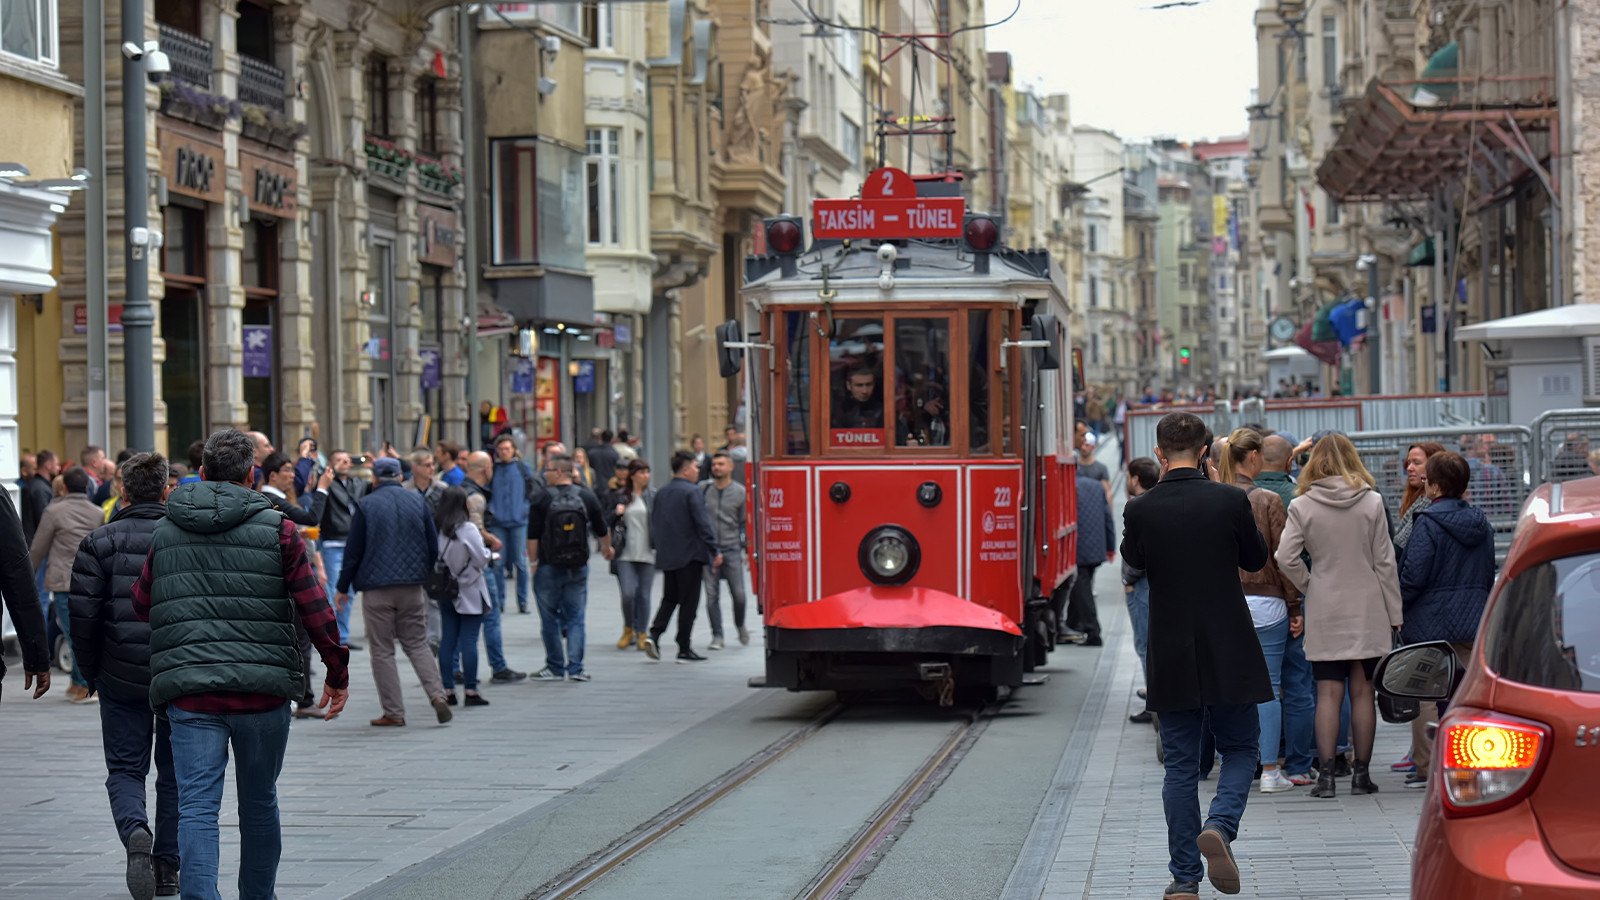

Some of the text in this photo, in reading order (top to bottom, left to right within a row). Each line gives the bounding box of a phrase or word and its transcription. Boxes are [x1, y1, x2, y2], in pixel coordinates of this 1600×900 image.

[882, 171, 894, 195] 2
[818, 204, 875, 230] TAKSİM
[906, 204, 957, 229] TÜNEL
[836, 431, 880, 443] TÜNEL
[769, 488, 784, 508] 223
[994, 486, 1011, 507] 223
